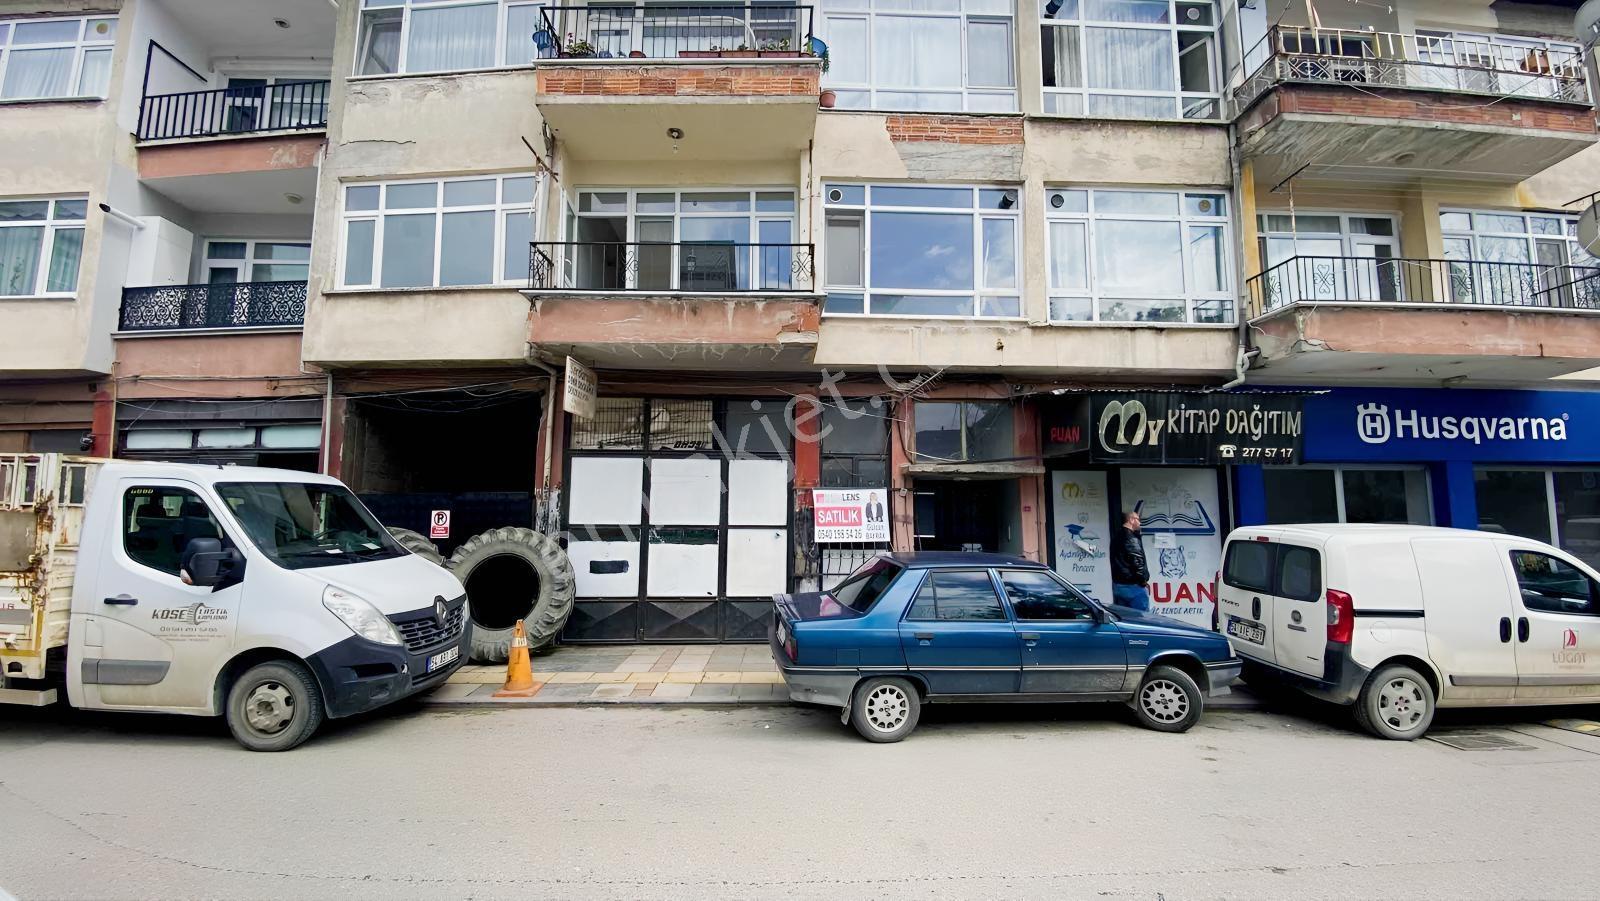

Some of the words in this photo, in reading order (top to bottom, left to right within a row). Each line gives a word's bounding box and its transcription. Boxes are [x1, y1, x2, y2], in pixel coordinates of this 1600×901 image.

[1167, 403, 1219, 434] KİTAP
[1225, 404, 1302, 441] DAĞITIM
[1395, 408, 1567, 445] Husqvarna
[1050, 426, 1080, 443] PUAN
[1242, 448, 1262, 457] 277
[1264, 448, 1277, 457] 57
[1280, 448, 1293, 457] 17
[842, 493, 860, 502] LENS
[817, 510, 859, 524] SATILIK
[1147, 582, 1215, 603] UAN
